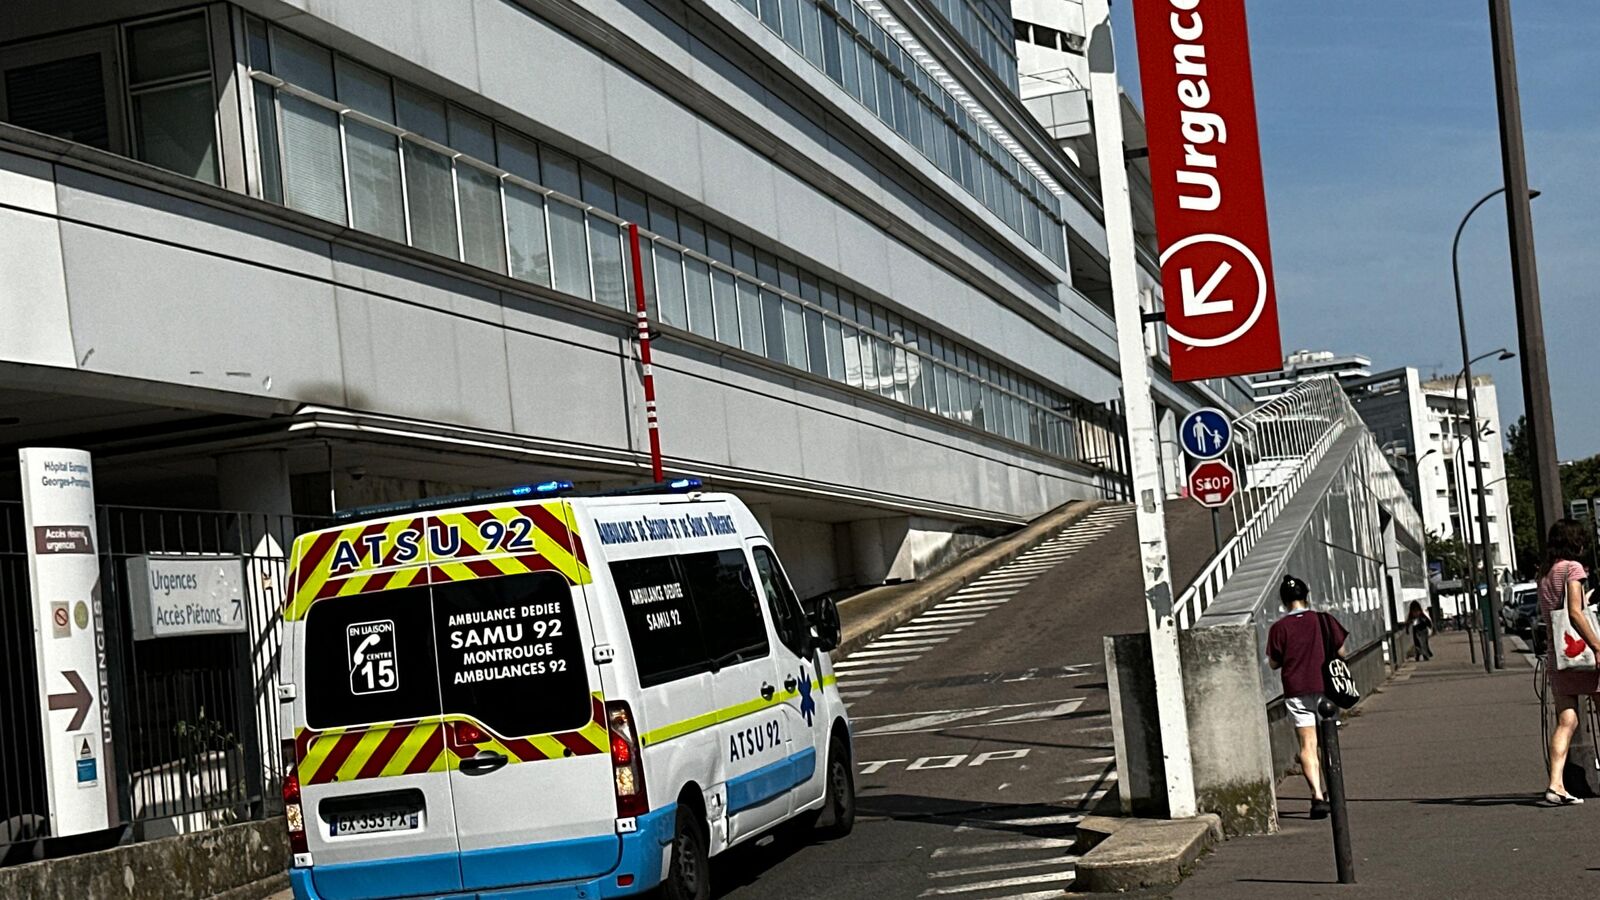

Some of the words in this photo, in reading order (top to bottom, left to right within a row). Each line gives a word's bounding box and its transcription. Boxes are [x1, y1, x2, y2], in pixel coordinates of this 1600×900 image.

[1169, 0, 1227, 211] Urgenc
[329, 526, 460, 572] ATSU
[480, 517, 534, 550] 92
[151, 569, 198, 596] Urgences
[629, 585, 665, 606] AMBULANCE
[157, 603, 186, 626] Accès
[186, 602, 222, 625] Piétons
[448, 607, 516, 627] AMBULANCE
[521, 602, 561, 617] DEDIEE
[646, 612, 671, 631] SAMU
[670, 608, 682, 626] 92
[349, 627, 360, 636] EN
[361, 623, 392, 635] LIAISON
[450, 623, 523, 649] SAMU
[533, 619, 563, 639] 92
[366, 651, 392, 661] CENTRE
[463, 637, 553, 665] MONTROUGE
[361, 659, 395, 690] 15
[453, 661, 546, 685] AMBULANCES
[549, 659, 567, 673] 92
[730, 725, 764, 763] ATSU
[766, 719, 781, 749] 92
[857, 748, 1031, 775] TOP
